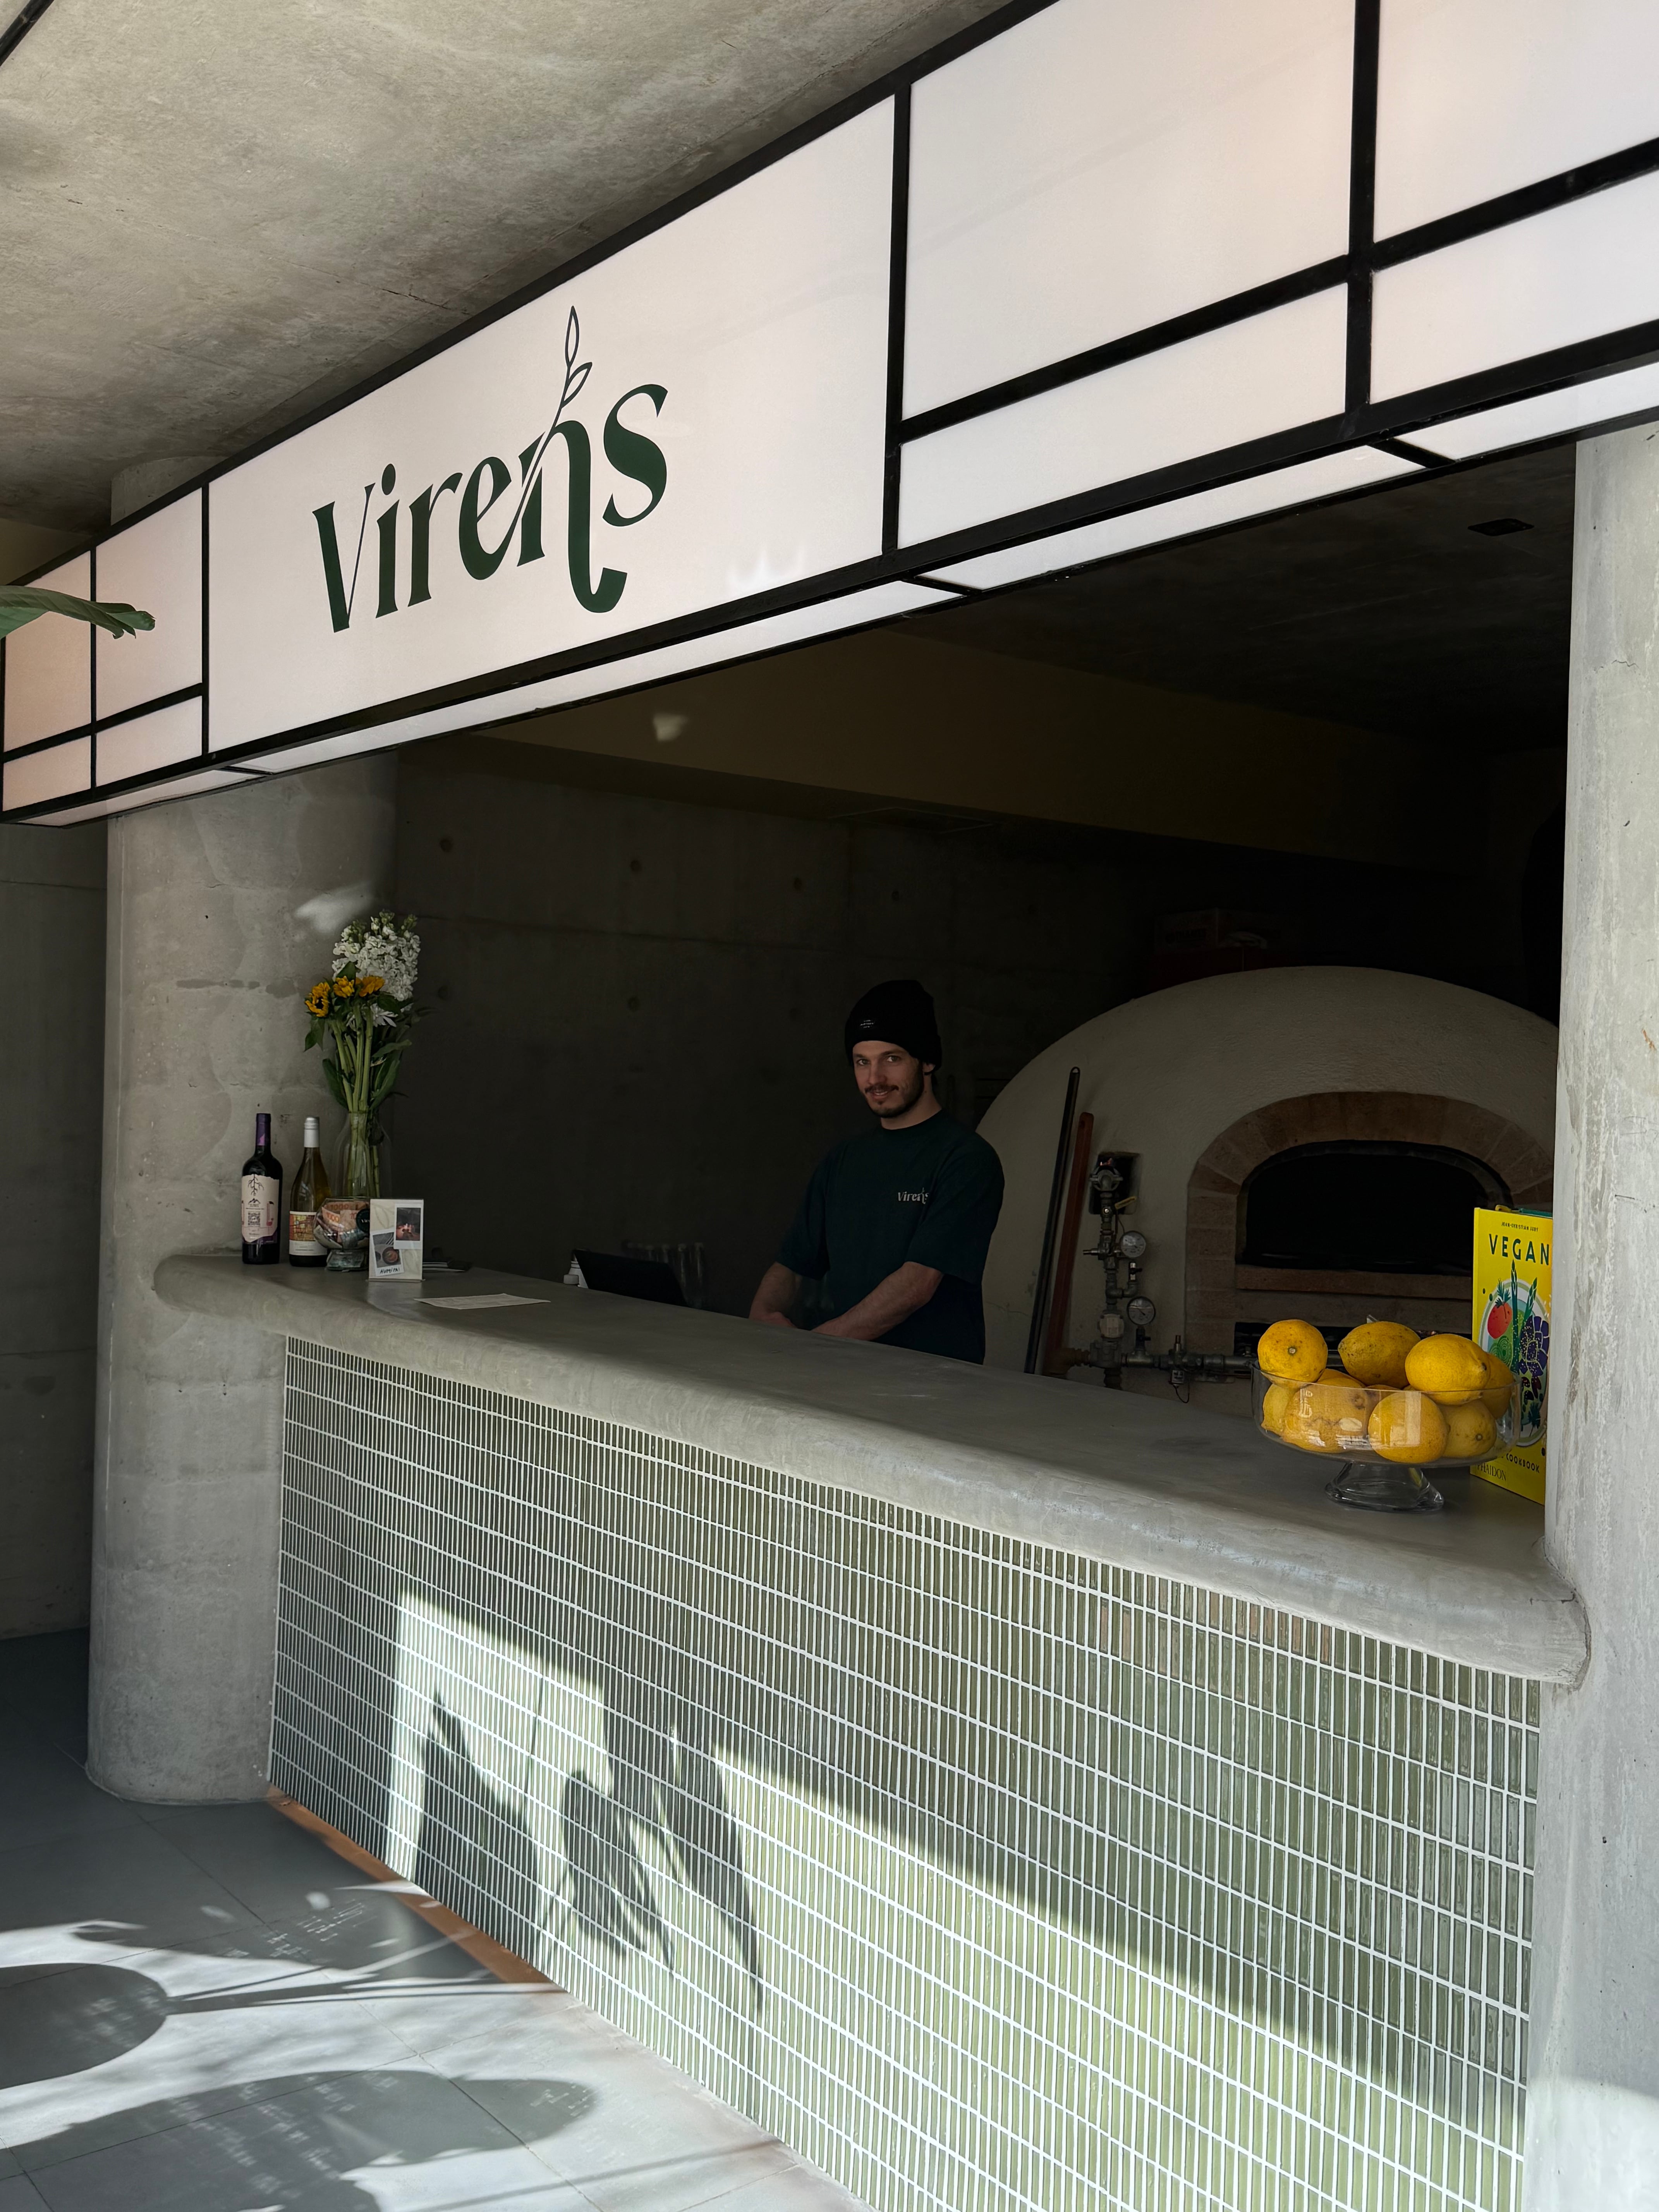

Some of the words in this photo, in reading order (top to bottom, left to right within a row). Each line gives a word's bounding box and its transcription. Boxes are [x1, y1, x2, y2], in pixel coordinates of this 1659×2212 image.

[312, 306, 668, 613] Virens
[898, 1187, 929, 1205] Virens
[1489, 1233, 1549, 1266] VEGAN
[1477, 1462, 1506, 1481] PHAIDON
[1506, 1453, 1540, 1473] COOKBOOK
